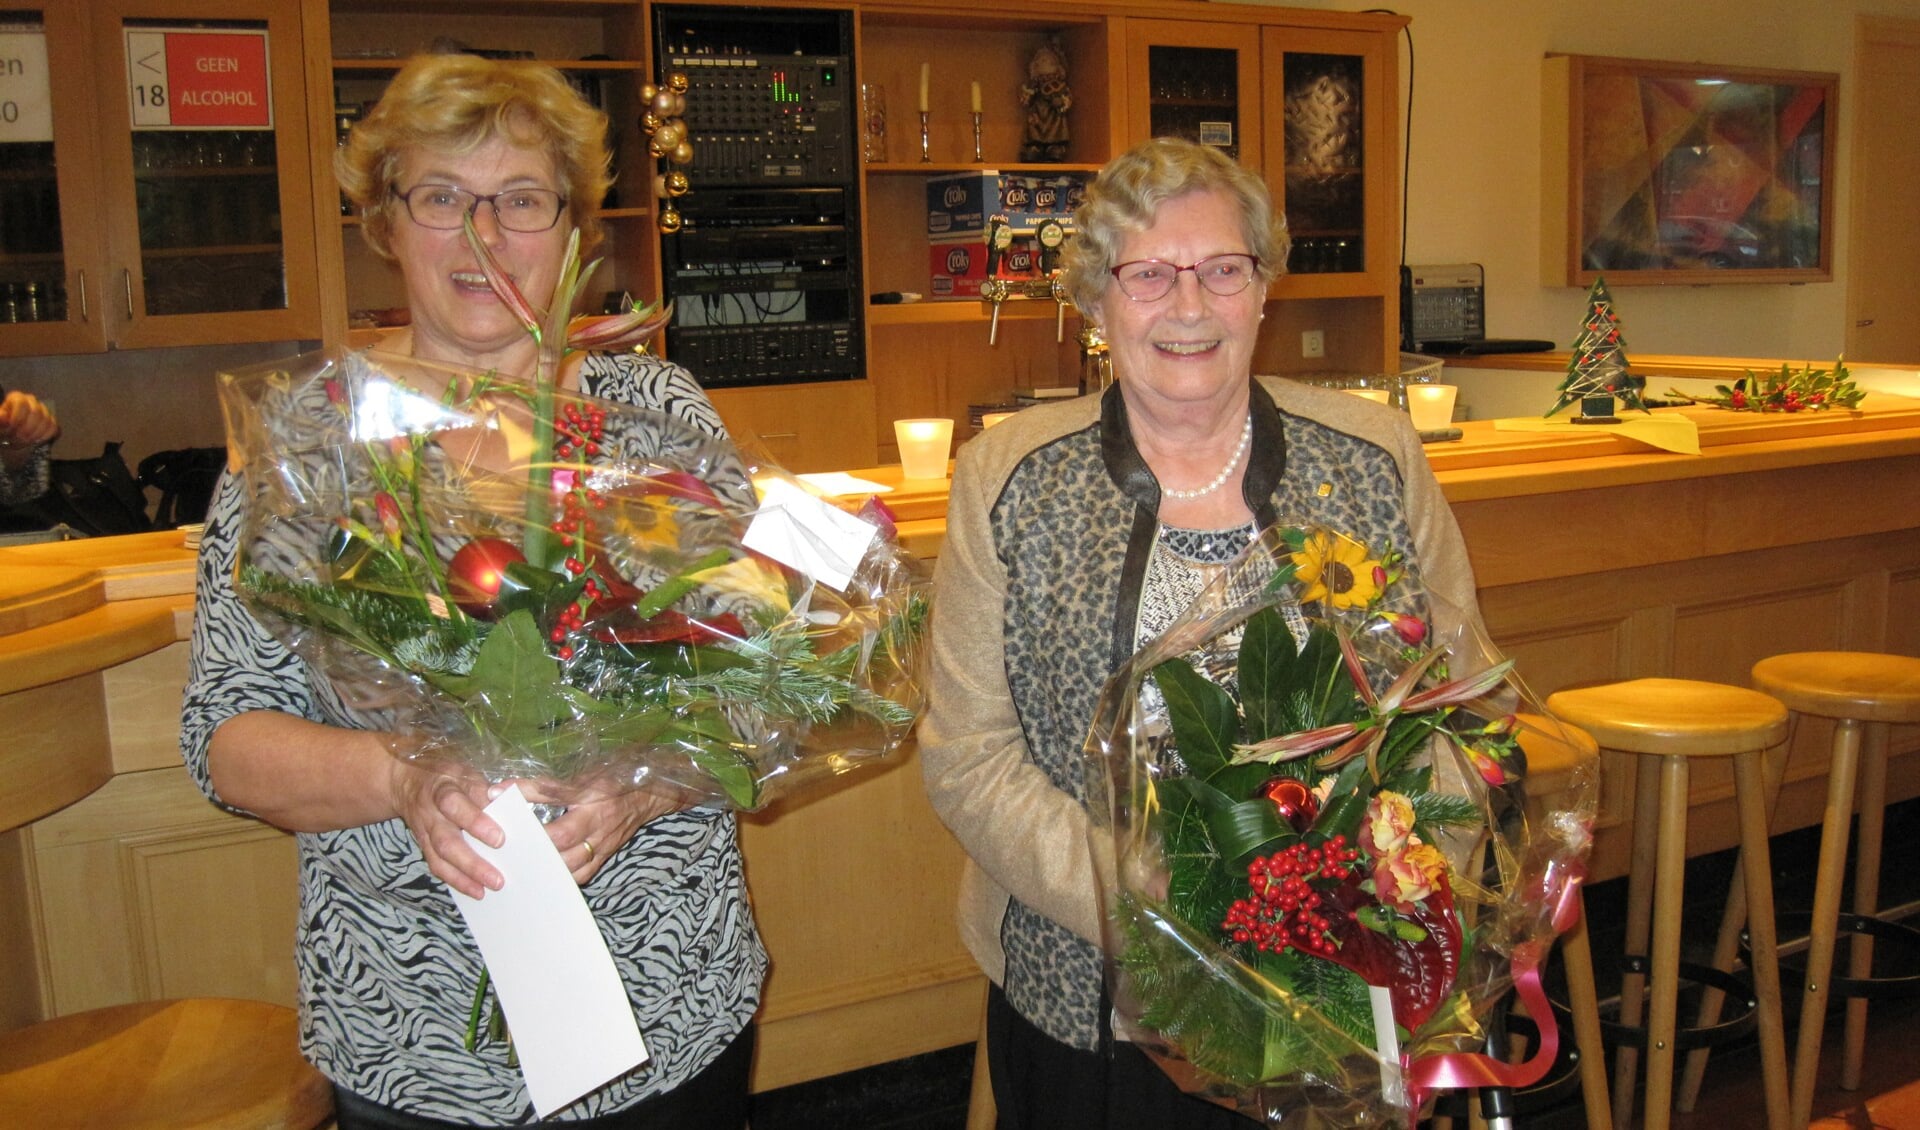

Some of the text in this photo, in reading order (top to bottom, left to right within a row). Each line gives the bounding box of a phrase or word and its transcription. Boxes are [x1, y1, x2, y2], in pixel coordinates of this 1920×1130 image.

[196, 57, 239, 73] GEEN
[136, 84, 165, 107] 18
[181, 91, 257, 106] ALCOHOL
[0, 100, 18, 123] 0
[944, 185, 967, 208] Croky
[1036, 189, 1057, 207] Crok
[1054, 217, 1073, 225] HIPS
[947, 250, 970, 273] Croky
[1009, 253, 1030, 271] Crok
